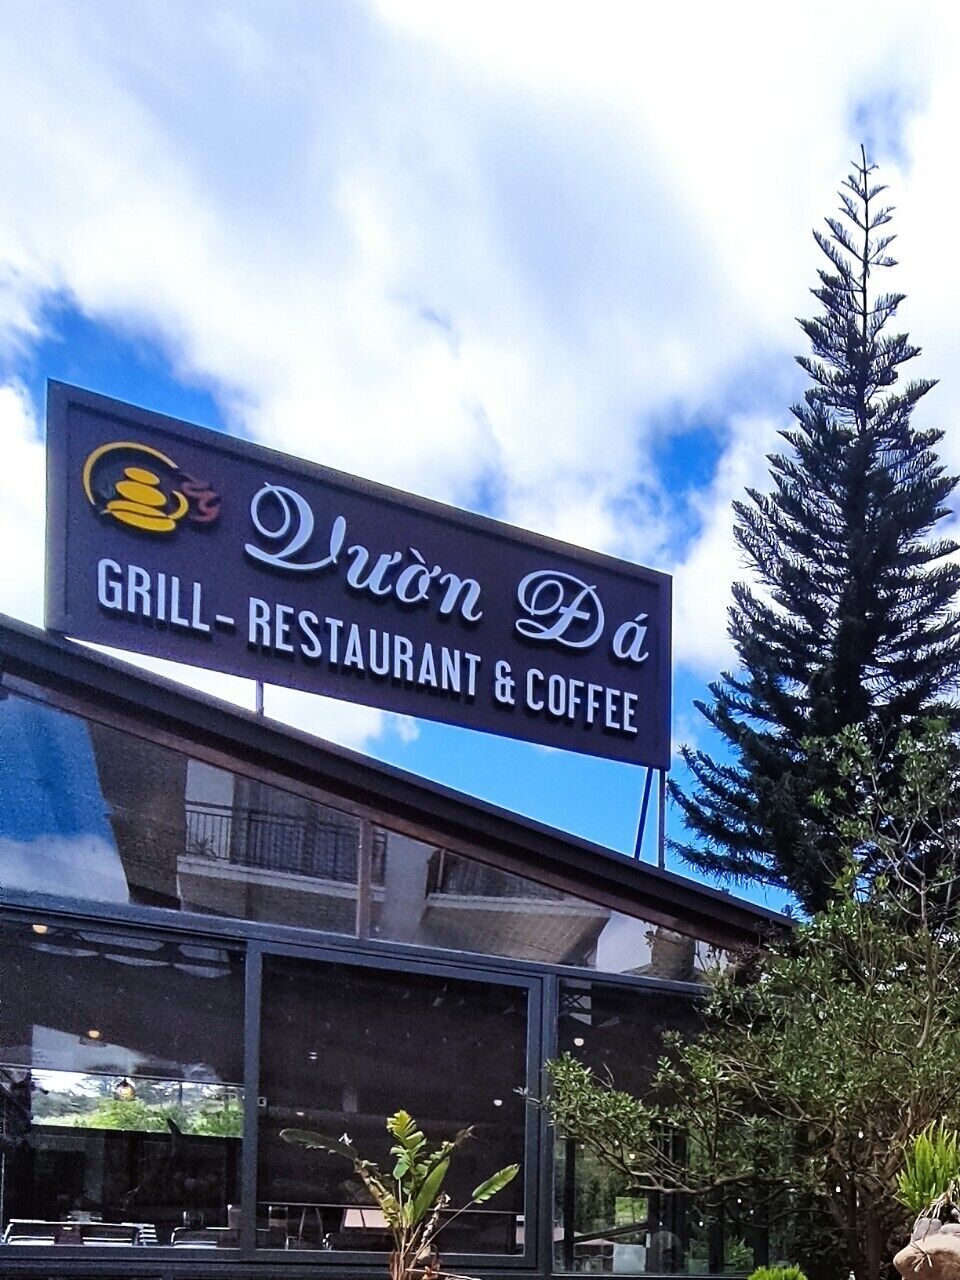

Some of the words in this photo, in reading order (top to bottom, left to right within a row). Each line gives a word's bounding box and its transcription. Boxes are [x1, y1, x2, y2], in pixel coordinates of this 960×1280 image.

[244, 482, 483, 621] Vườn
[516, 569, 649, 663] Đá
[249, 596, 482, 696] RESTAURANT
[495, 660, 516, 704] &
[526, 669, 639, 734] COFFEE
